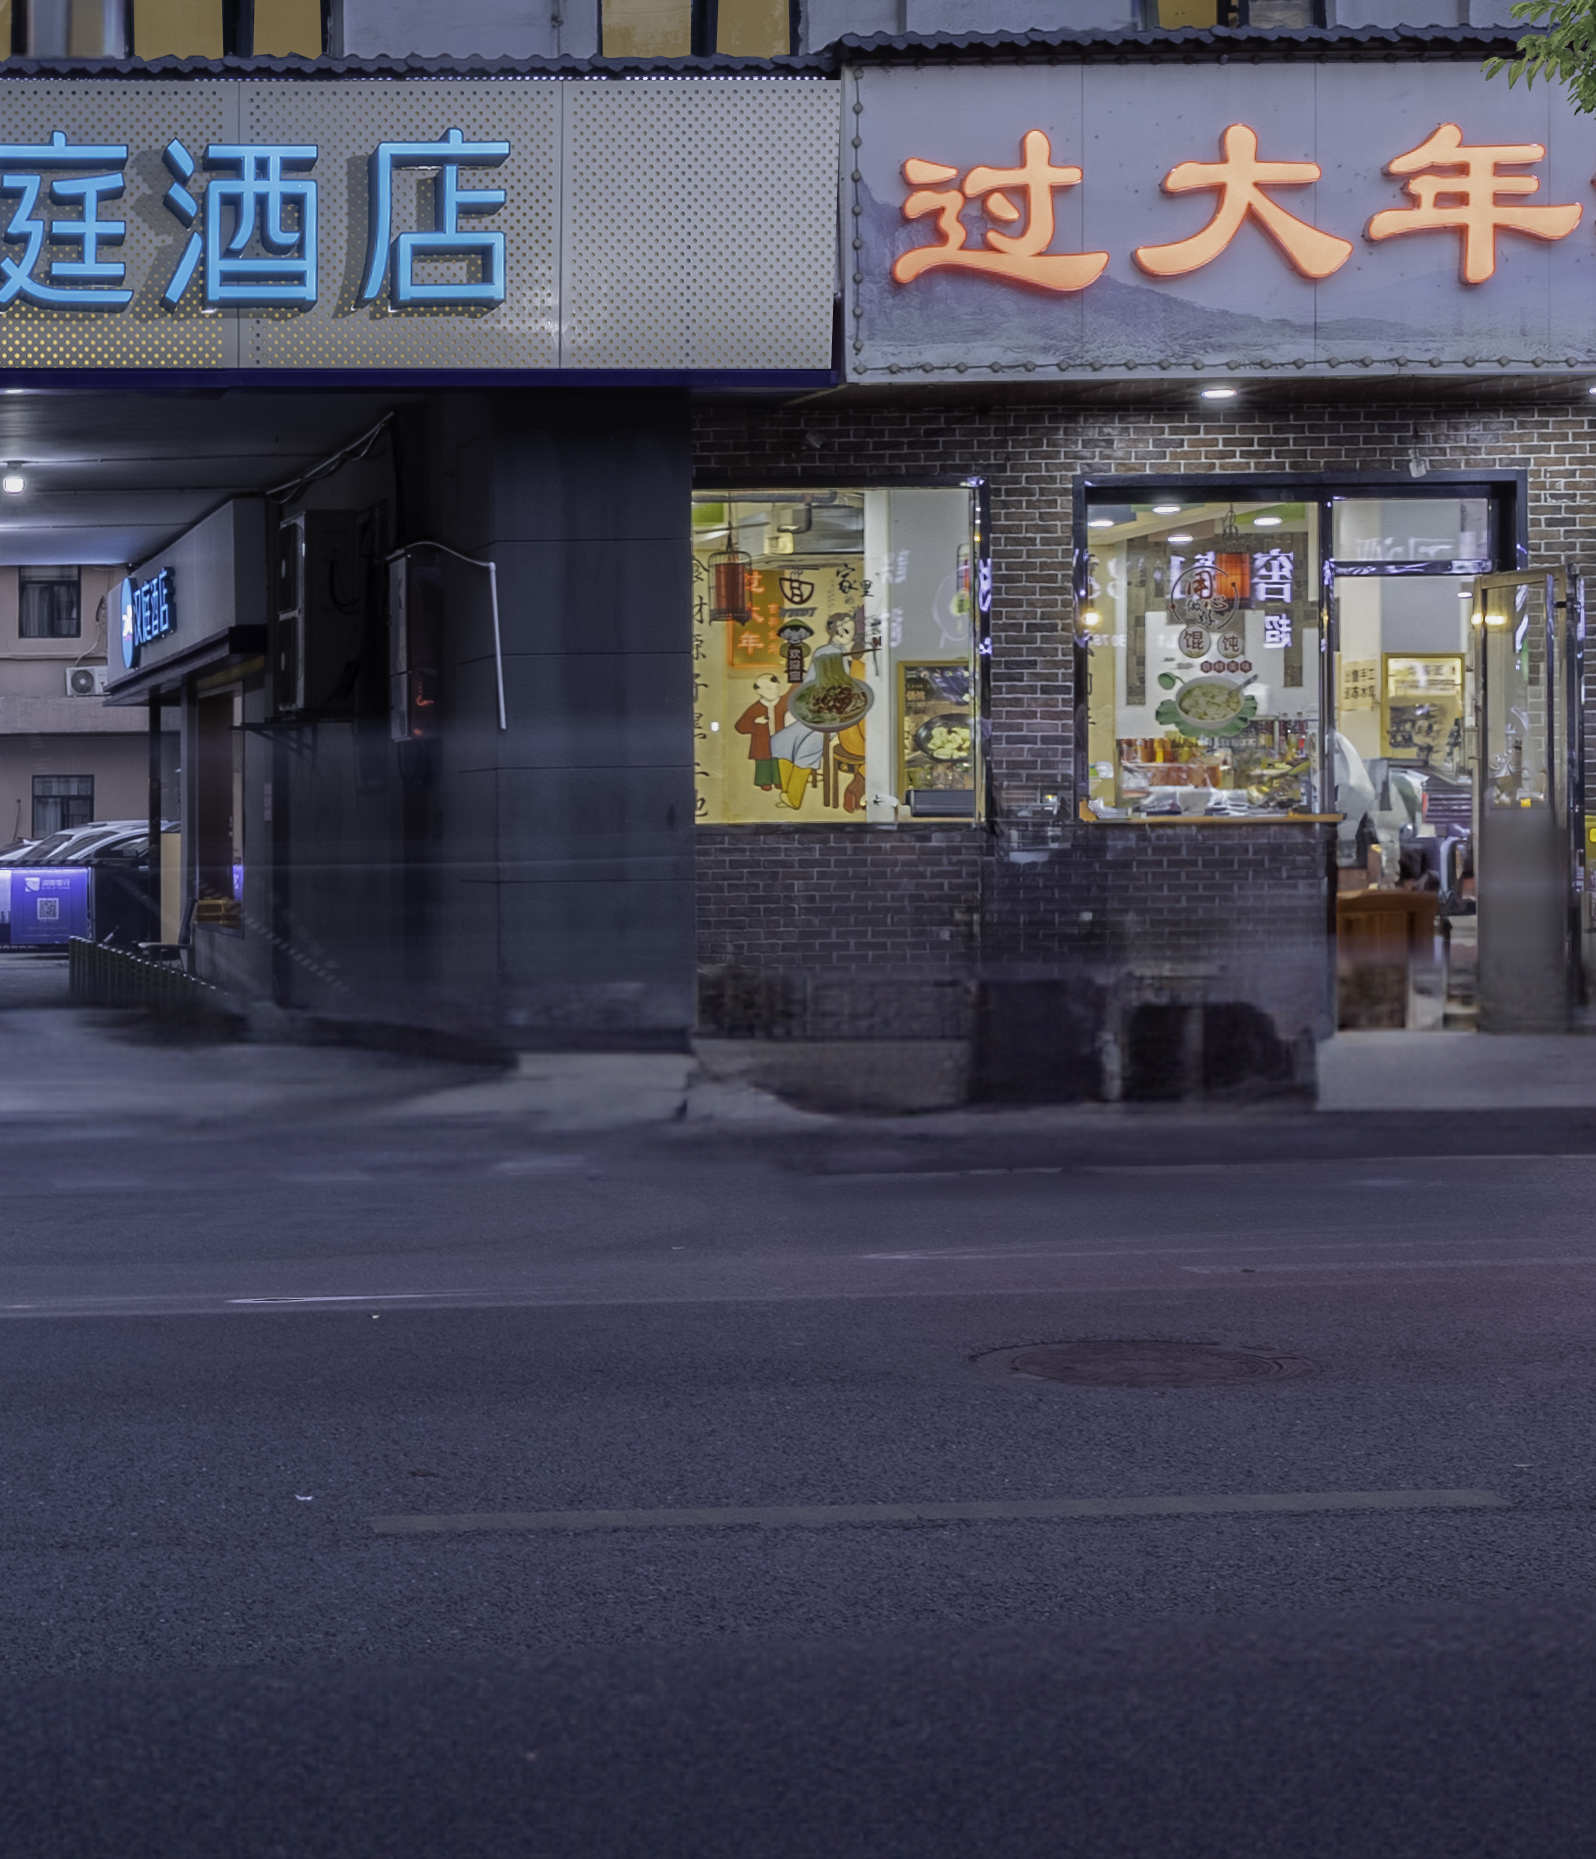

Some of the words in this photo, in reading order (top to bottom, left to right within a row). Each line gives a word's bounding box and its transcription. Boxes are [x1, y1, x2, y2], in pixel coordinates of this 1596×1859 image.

[133, 567, 169, 646] 汉庭酒店
[1184, 630, 1240, 652] 馄饨
[789, 648, 802, 681] 欢迎您
